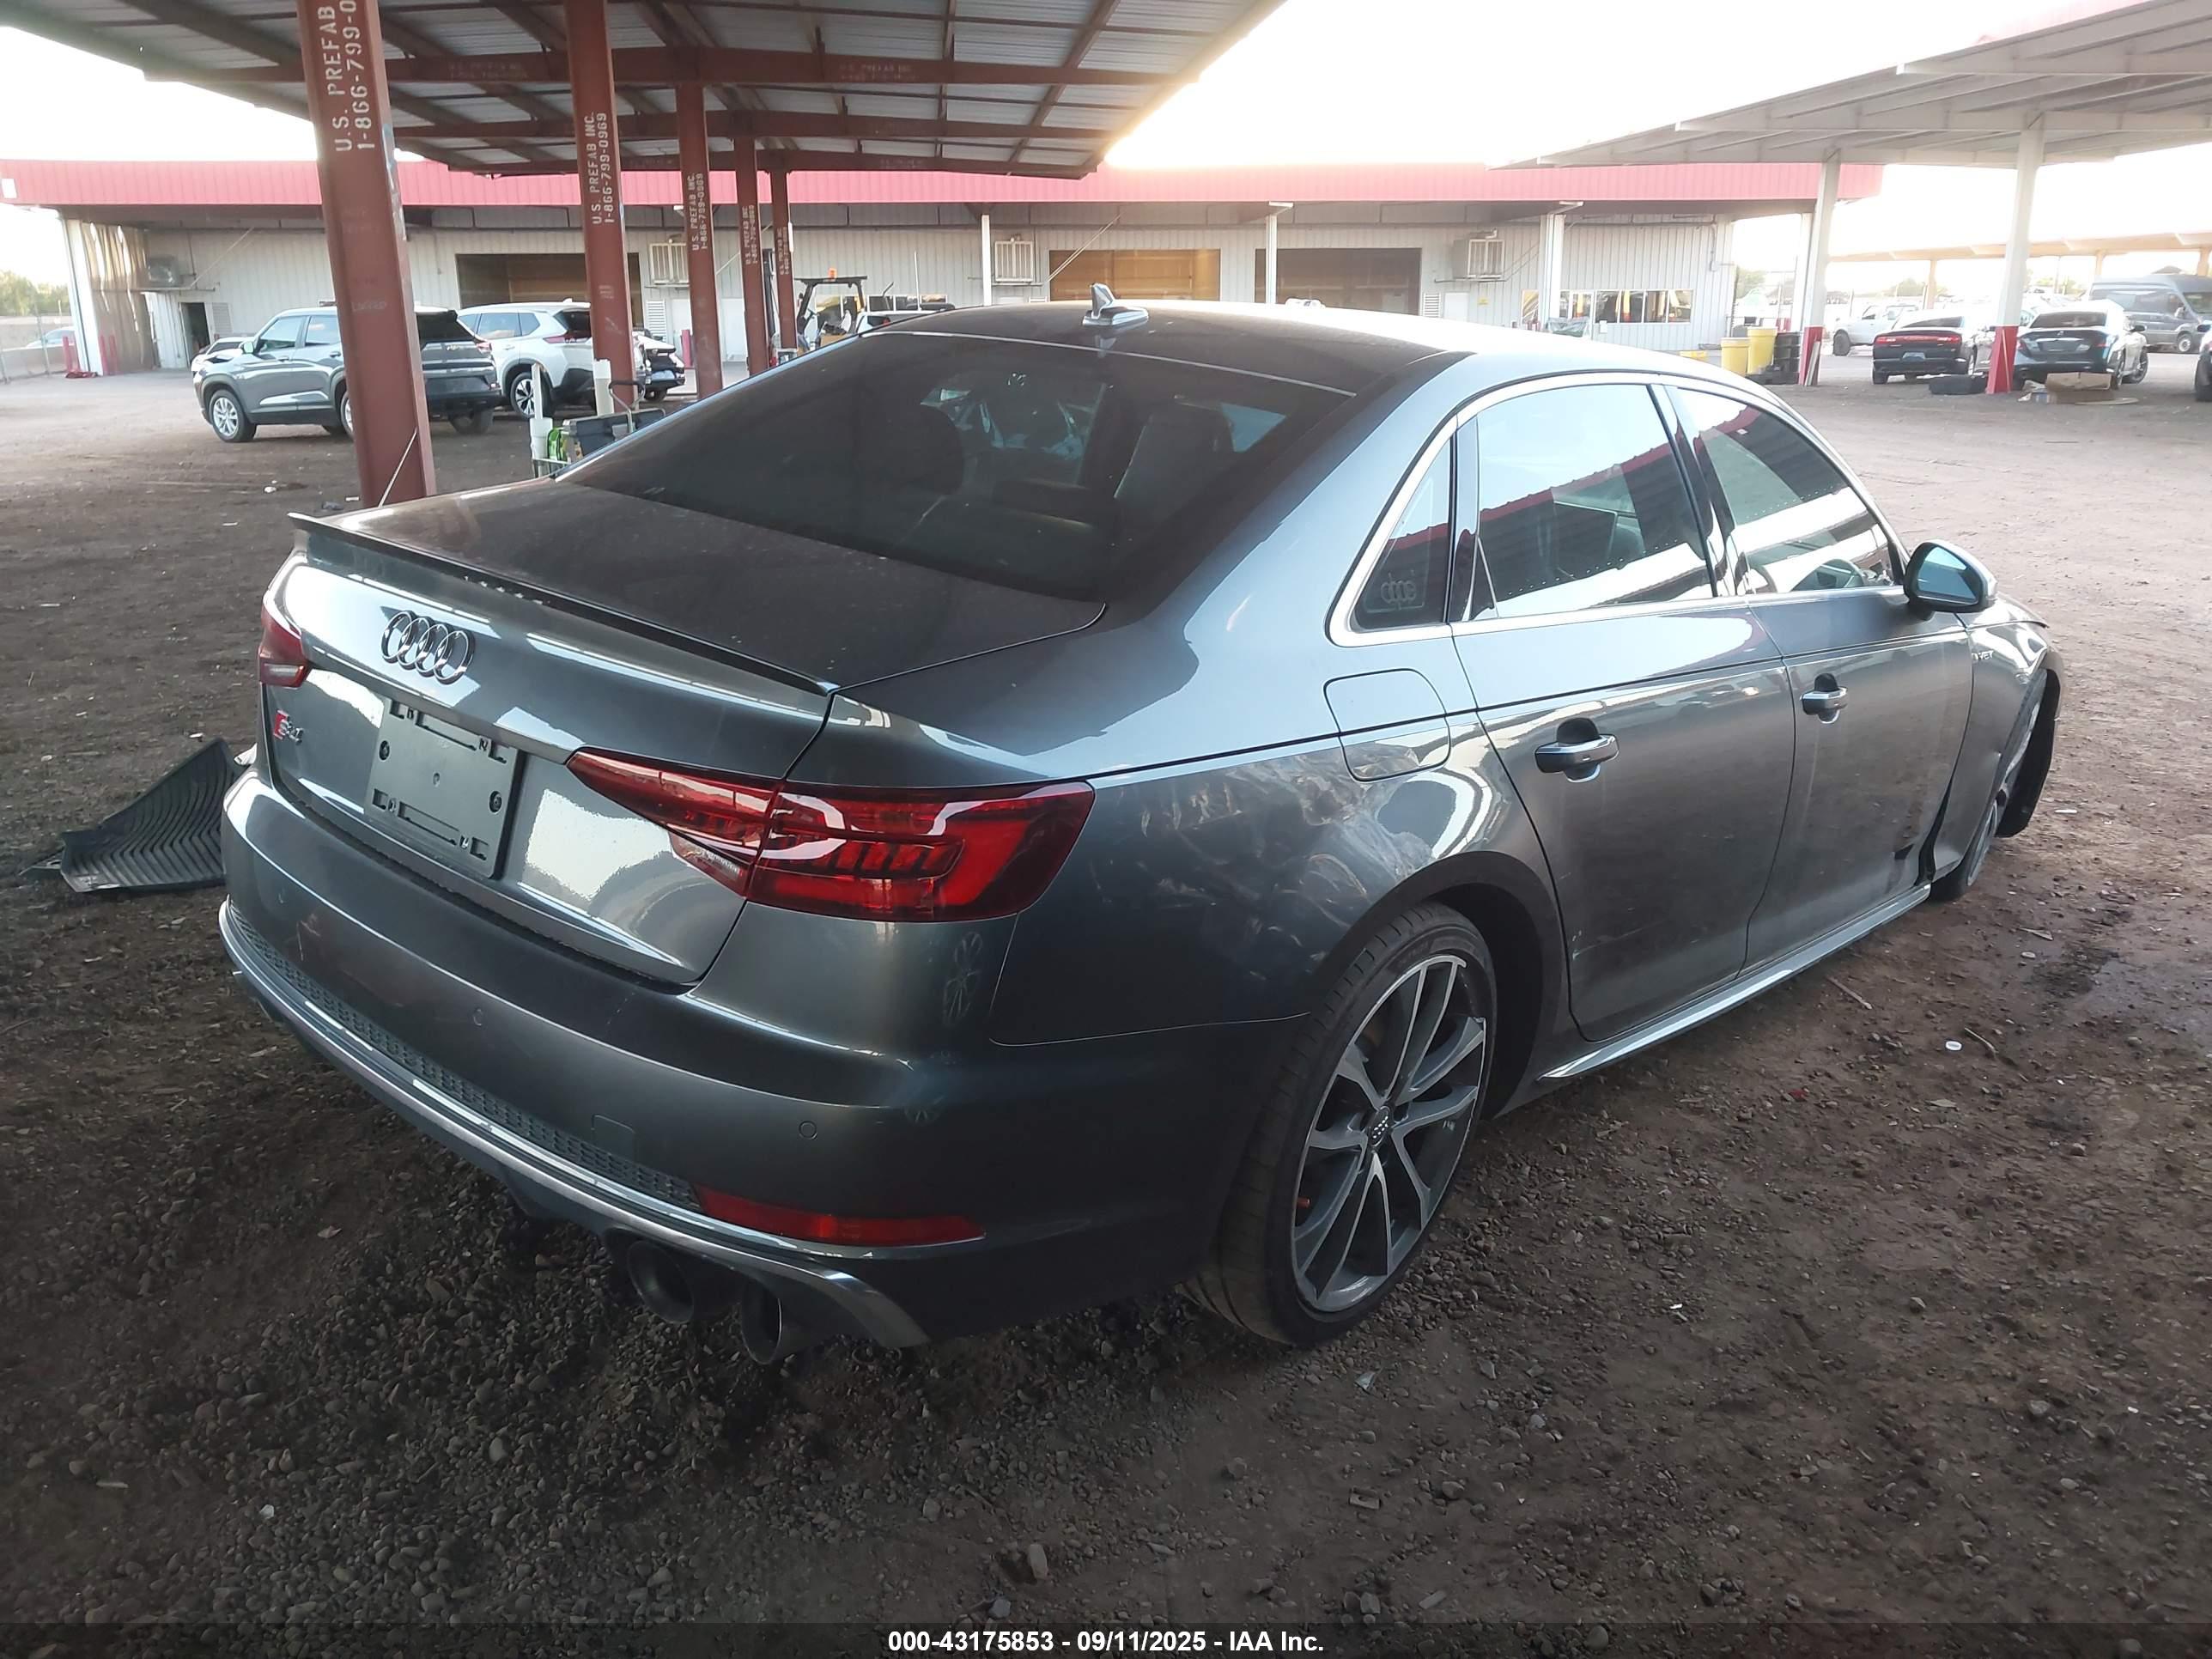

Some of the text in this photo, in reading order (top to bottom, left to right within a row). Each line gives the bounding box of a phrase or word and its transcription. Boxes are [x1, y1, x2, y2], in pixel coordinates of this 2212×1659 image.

[318, 6, 353, 152] U.S. PREFAB
[586, 143, 600, 193] PREFAB
[596, 112, 615, 223] 1-866-799-0969
